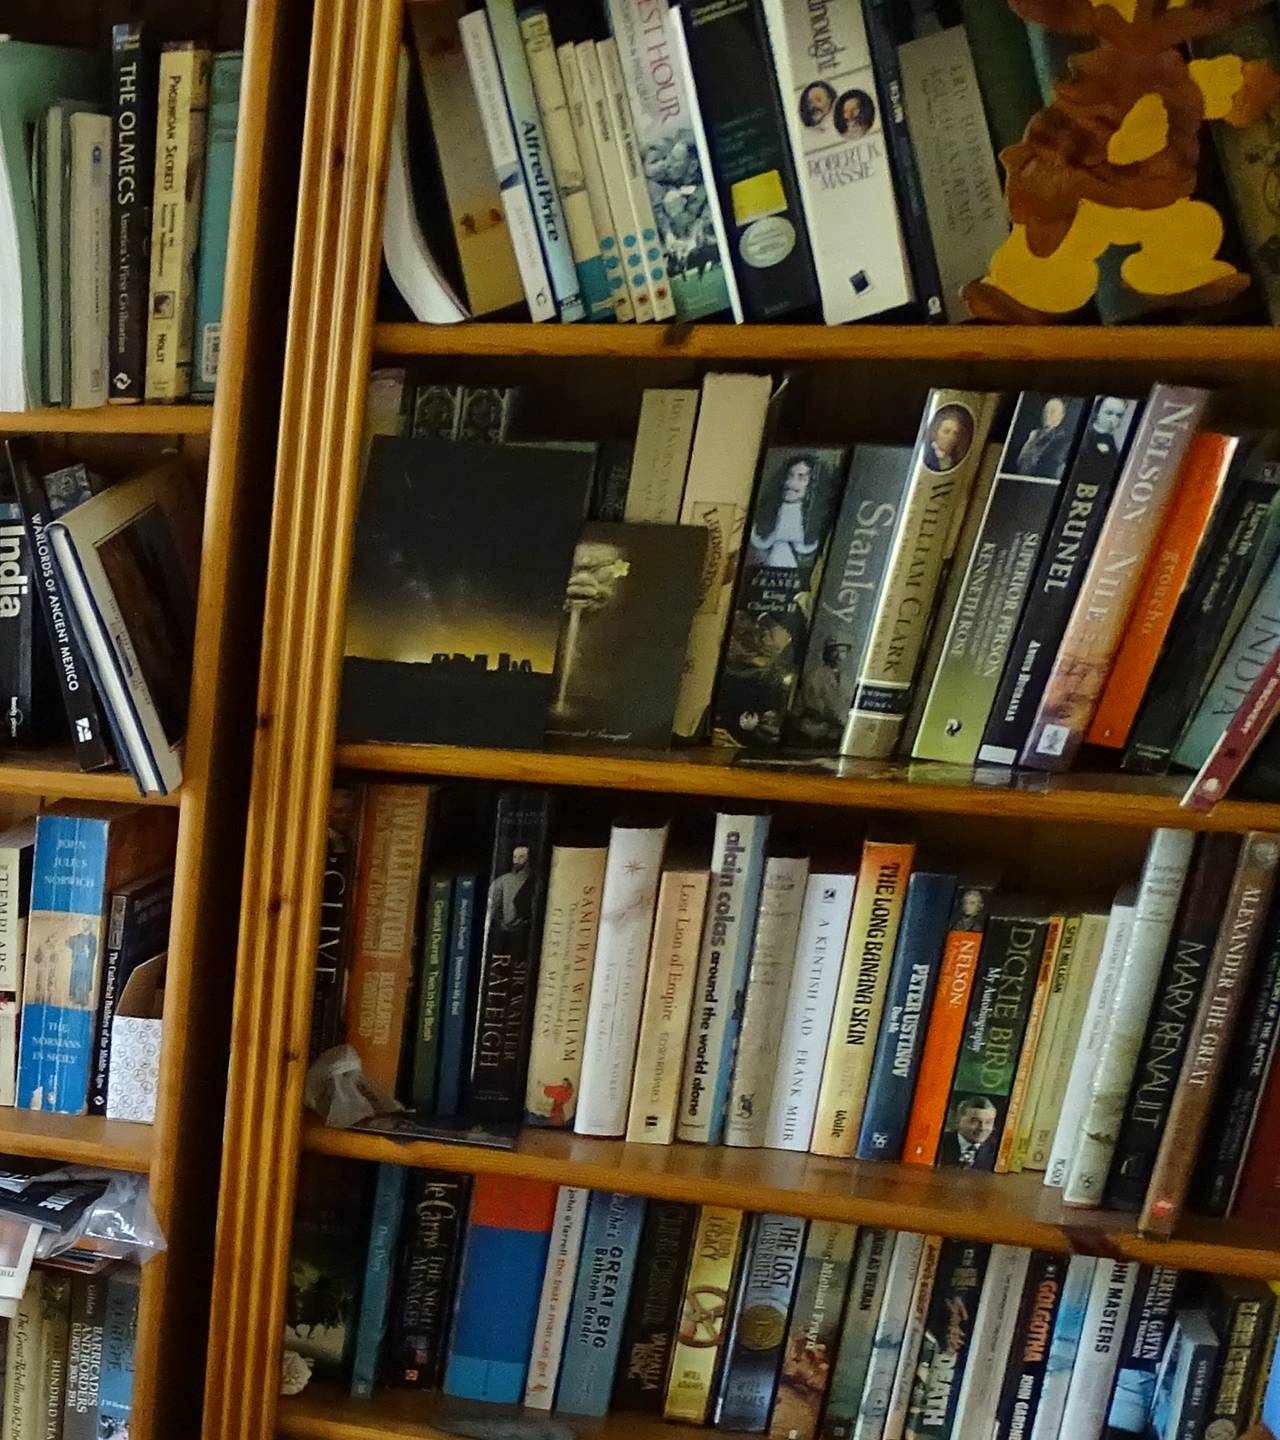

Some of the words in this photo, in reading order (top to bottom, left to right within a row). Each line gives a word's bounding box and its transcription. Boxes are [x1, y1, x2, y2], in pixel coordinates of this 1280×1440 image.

[118, 62, 137, 105] THE
[646, 40, 682, 123] HOUR
[117, 111, 137, 206] OLMECS
[520, 120, 556, 194] Alfred
[539, 197, 563, 242] Price
[155, 333, 168, 363] HOLST
[1119, 400, 1197, 525] NELSON
[821, 500, 897, 624] Stanley
[905, 481, 956, 587] WILLIAM
[1042, 483, 1101, 594] BRUNEL
[958, 541, 997, 618] KENNETH
[1002, 531, 1041, 611] SUPERIOR
[1085, 549, 1139, 622] NILE
[32, 512, 54, 578] WARLORDS
[49, 595, 69, 643] ANCIENT
[60, 647, 81, 691] MEXICO
[882, 598, 924, 673] CLARK
[984, 614, 1019, 676] PERSON
[718, 831, 744, 887] alain
[875, 861, 901, 895] THE
[679, 883, 696, 912] Lost
[710, 891, 737, 947] colas
[867, 897, 893, 939] LONG
[573, 884, 597, 973] SAMURAI
[673, 918, 692, 950] Lion
[1215, 886, 1261, 989] ALEXANDER
[104, 965, 118, 999] Cathedral
[660, 972, 683, 1021] Empire
[704, 951, 728, 1003] around
[806, 936, 828, 1000] KENTISH
[856, 940, 886, 1004] BANANA
[901, 963, 930, 1012] PETER
[995, 925, 1037, 1019] DICKIE
[1052, 952, 1073, 995] MILLIGAN
[1163, 939, 1208, 1019] MARY
[102, 1000, 114, 1028] Builders
[478, 952, 512, 1068] RALEIGH
[561, 980, 587, 1064] WILLIAM
[700, 1006, 717, 1031] the
[801, 1007, 818, 1037] LAD
[846, 1006, 874, 1046] SKIN
[966, 985, 1000, 1053] Autobiography
[1205, 993, 1232, 1029] THE
[98, 1048, 110, 1073] Middle
[692, 1033, 713, 1074] world
[790, 1049, 810, 1098] FRANK
[891, 1013, 922, 1078] USTINOV
[980, 1026, 1014, 1088] BIRD
[1189, 1033, 1220, 1089] GREAT
[687, 1077, 707, 1117] alone
[1131, 1021, 1185, 1128] RENAULT
[779, 1225, 801, 1251] THE
[587, 1247, 609, 1301] Bathroom
[601, 1246, 625, 1310] GREAT
[772, 1255, 795, 1289] LOST
[813, 1262, 835, 1310] Michael
[579, 1305, 598, 1345] Reader
[591, 1314, 611, 1348] BIG
[1022, 1279, 1060, 1362] GOLGOTHA
[1095, 1287, 1125, 1353] MASTERS
[1142, 1319, 1166, 1360] GAVIN
[46, 1359, 61, 1417] HUNDRED
[87, 1326, 104, 1407] BARRICADES
[922, 1352, 957, 1426] DEATH
[1018, 1373, 1036, 1400] JOHN
